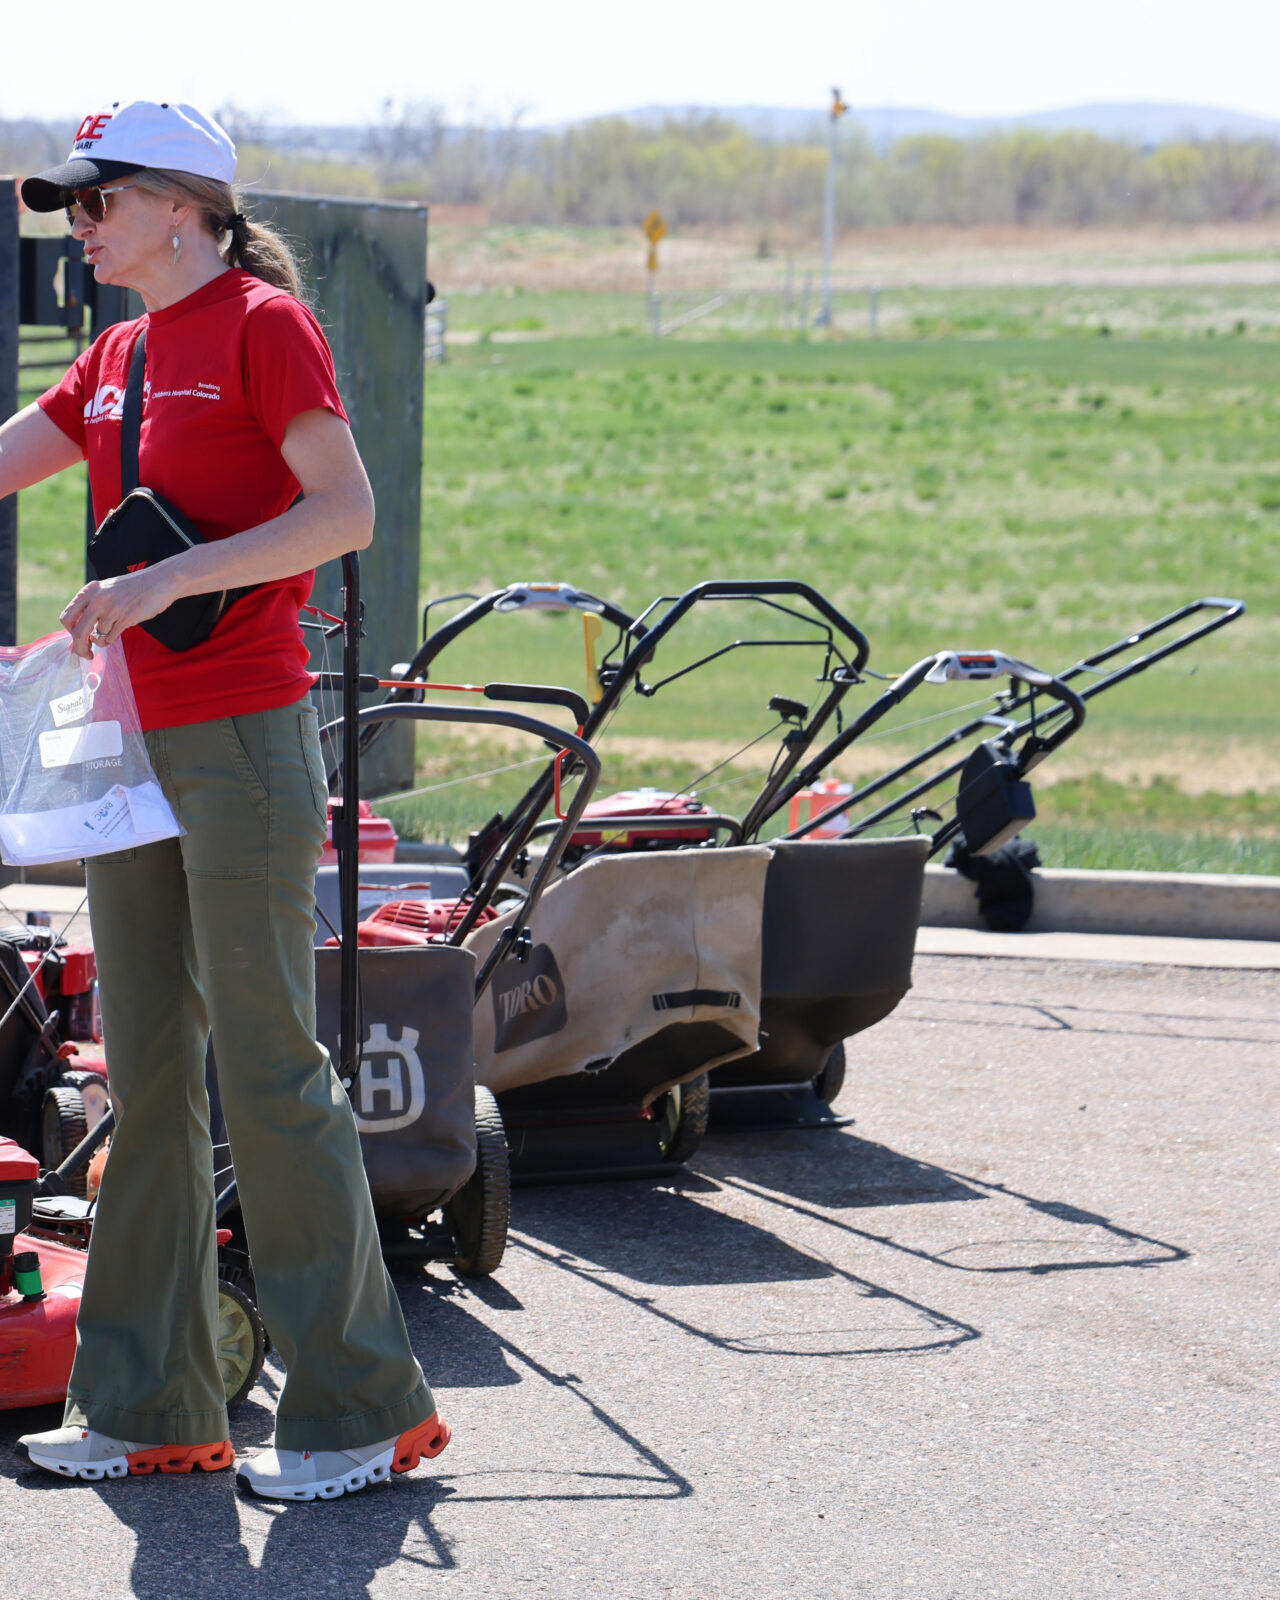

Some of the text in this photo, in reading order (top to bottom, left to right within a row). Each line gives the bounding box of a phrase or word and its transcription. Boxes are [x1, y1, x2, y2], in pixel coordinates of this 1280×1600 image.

[74, 114, 112, 141] CE
[171, 385, 192, 396] Hospital
[192, 384, 220, 401] Colorado
[499, 974, 558, 1024] TORO
